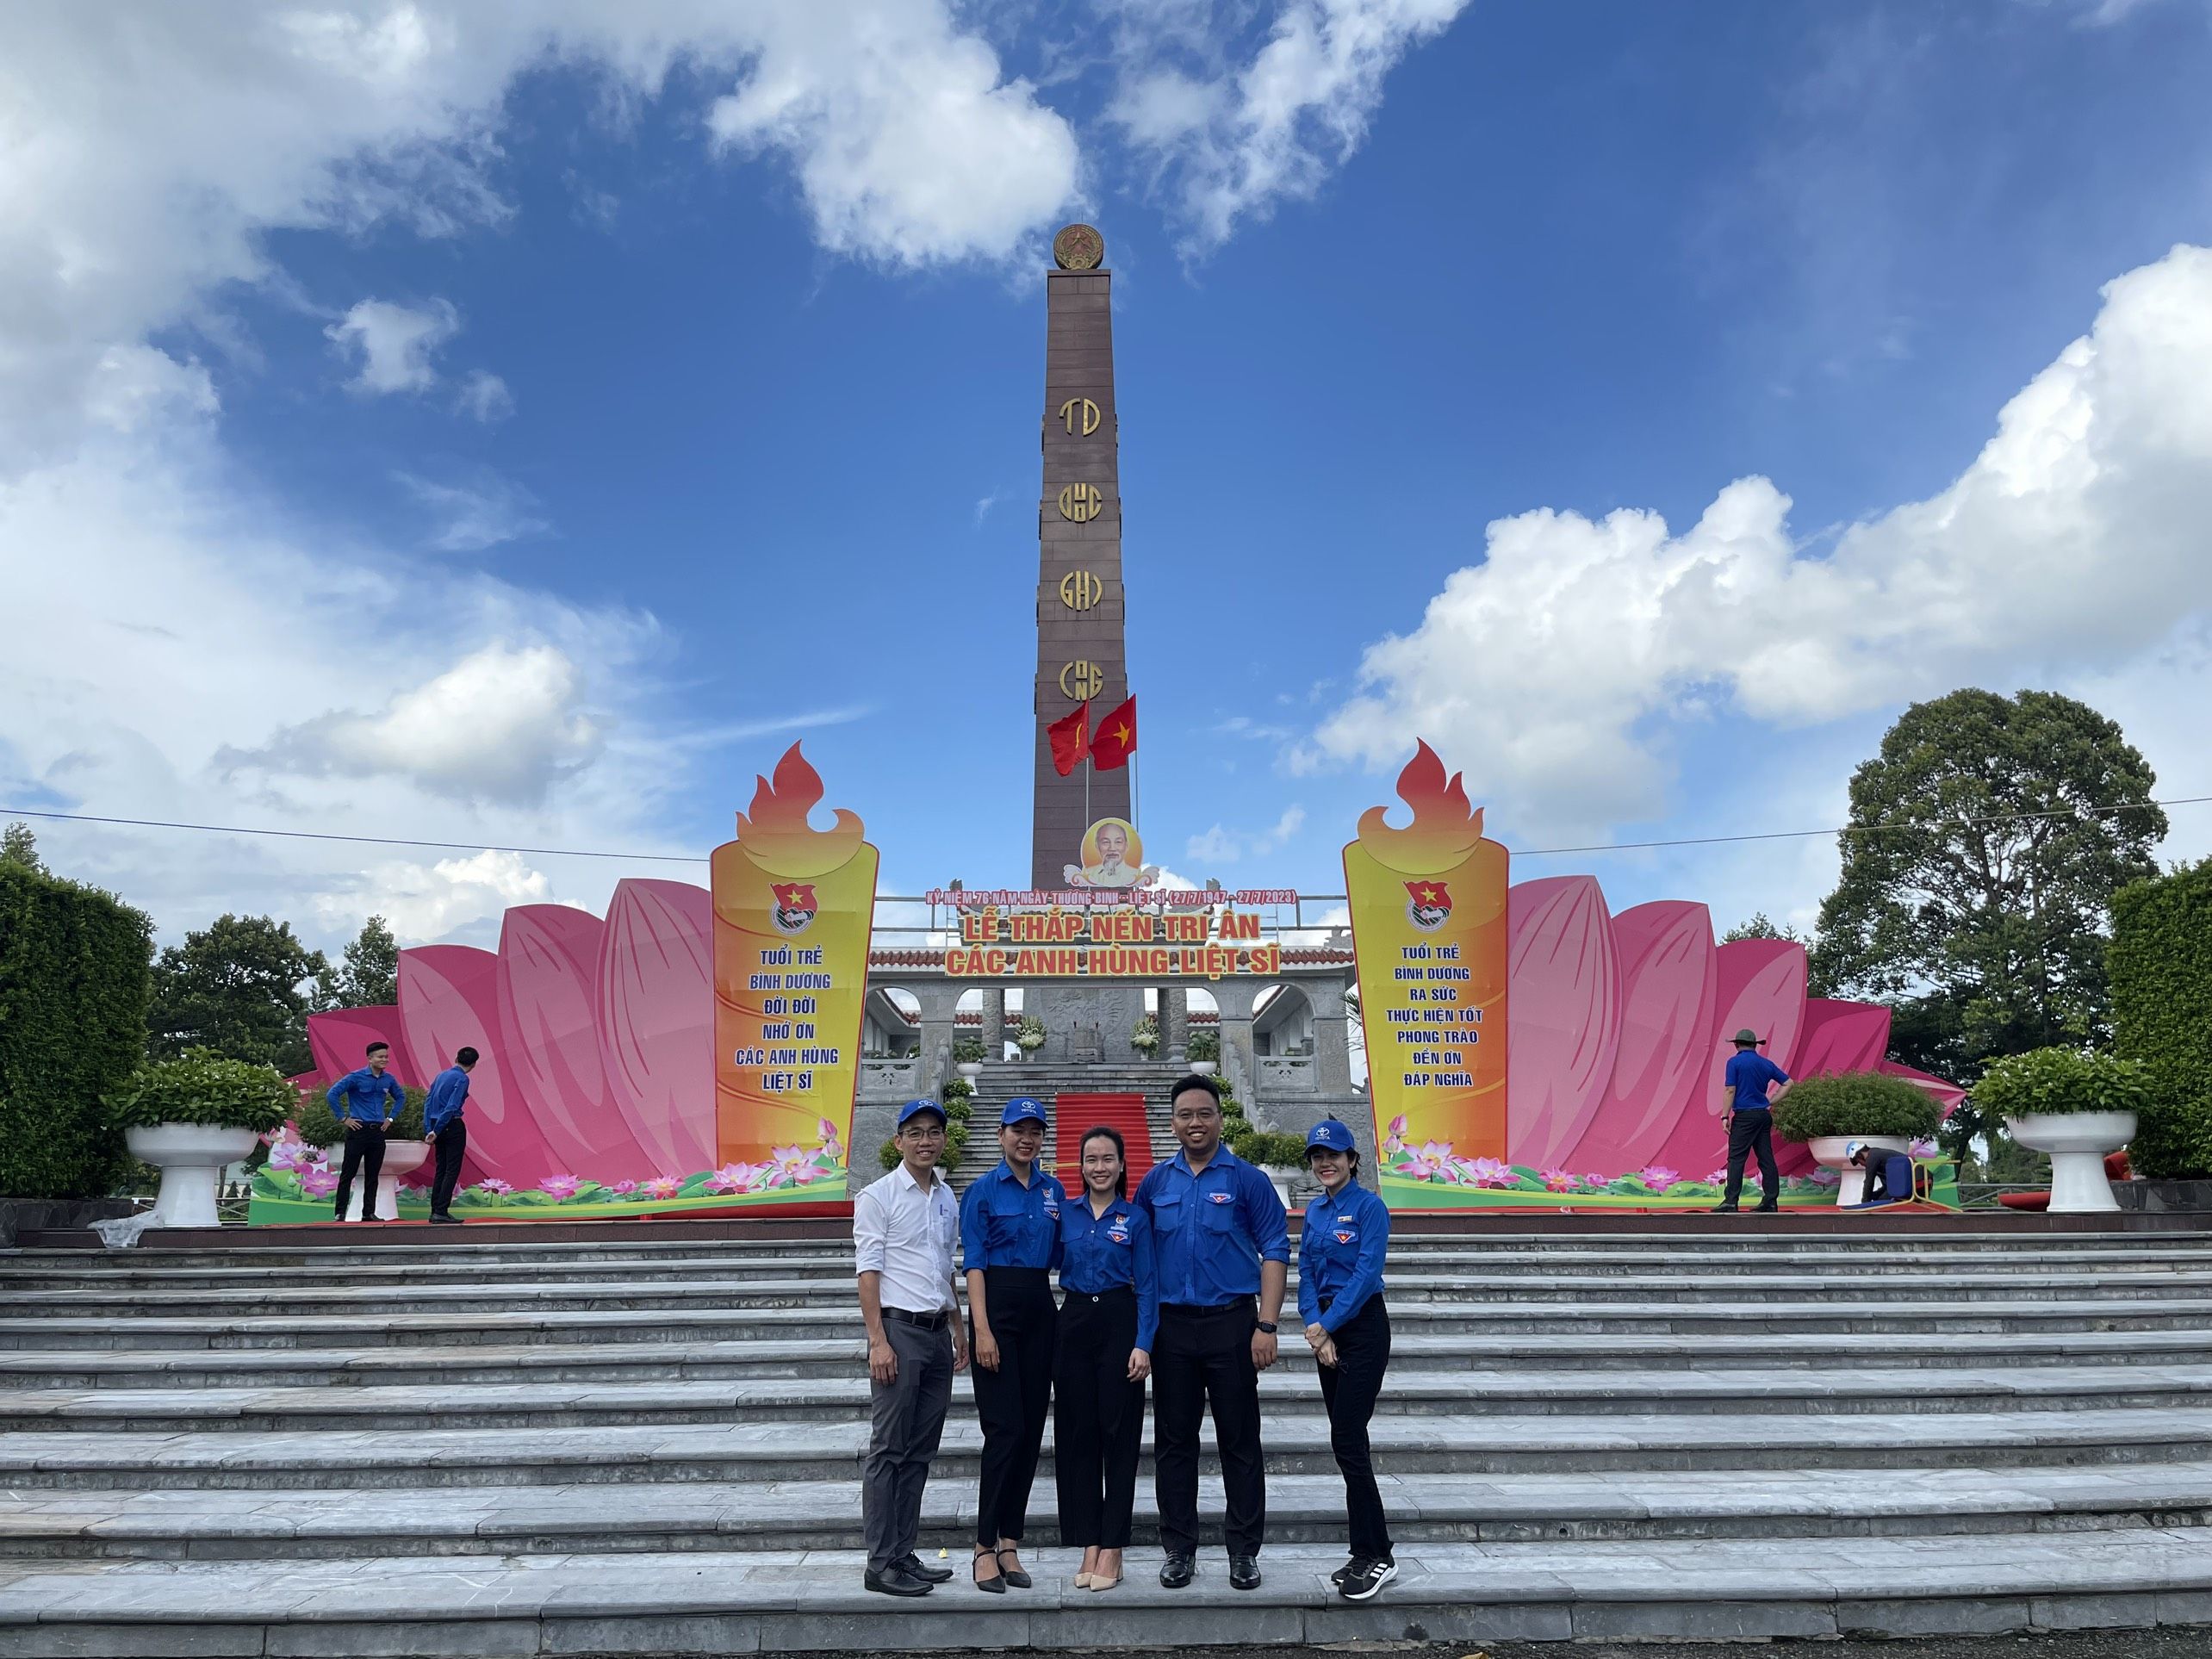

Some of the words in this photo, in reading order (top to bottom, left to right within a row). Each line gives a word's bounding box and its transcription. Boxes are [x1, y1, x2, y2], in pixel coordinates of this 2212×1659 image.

[927, 888, 941, 904] KỶ
[944, 890, 973, 907] NIỆM
[975, 891, 990, 904] 76
[992, 890, 1017, 904] NĂM
[1020, 889, 1048, 904] NGÀY
[1095, 892, 1119, 904] BINH
[1129, 889, 1153, 907] LIỆT
[1155, 889, 1166, 904] SĨ
[965, 907, 998, 941] LỄ
[1010, 907, 1084, 941] THẮP
[1092, 909, 1153, 941] NẾN
[1163, 915, 1209, 941] TRI
[1219, 910, 1260, 940] ÂN
[760, 943, 792, 965] TUỔI
[797, 944, 823, 965] TRẺ
[1401, 941, 1431, 959] TUỔI
[1435, 942, 1459, 959] TRẺ
[947, 945, 1005, 974] CÁC
[1016, 949, 1077, 974] ANH
[1089, 944, 1168, 974] HÙNG
[1180, 943, 1239, 979] LIỆT
[1251, 943, 1280, 974] SĨ
[749, 972, 781, 990] BÌNH
[786, 972, 830, 989] DƯƠNG
[1395, 965, 1423, 979] BÌNH
[1427, 966, 1469, 979] DƯƠNG
[1410, 989, 1426, 1001] RA
[1432, 985, 1457, 1001] SỨC
[764, 996, 787, 1014] ĐỜI
[792, 996, 816, 1014] ĐỜI
[1386, 1008, 1420, 1024] THỰC
[1424, 1007, 1454, 1024] HIỆN
[1458, 1006, 1482, 1022] TỐT
[762, 1021, 791, 1040] NHỚ
[795, 1022, 814, 1039] ƠN
[1397, 1030, 1439, 1043] PHONG
[1444, 1028, 1478, 1043] TRÀO
[736, 1046, 764, 1065] CÁC
[768, 1049, 797, 1065] ANH
[801, 1045, 838, 1064] HÙNG
[1413, 1047, 1439, 1065] ĐỀN
[1445, 1050, 1462, 1065] ƠN
[763, 1071, 793, 1093] LIỆT
[798, 1070, 812, 1089] SĨ
[1404, 1071, 1430, 1086] ĐÁP
[1434, 1071, 1473, 1086] NGHĨA
